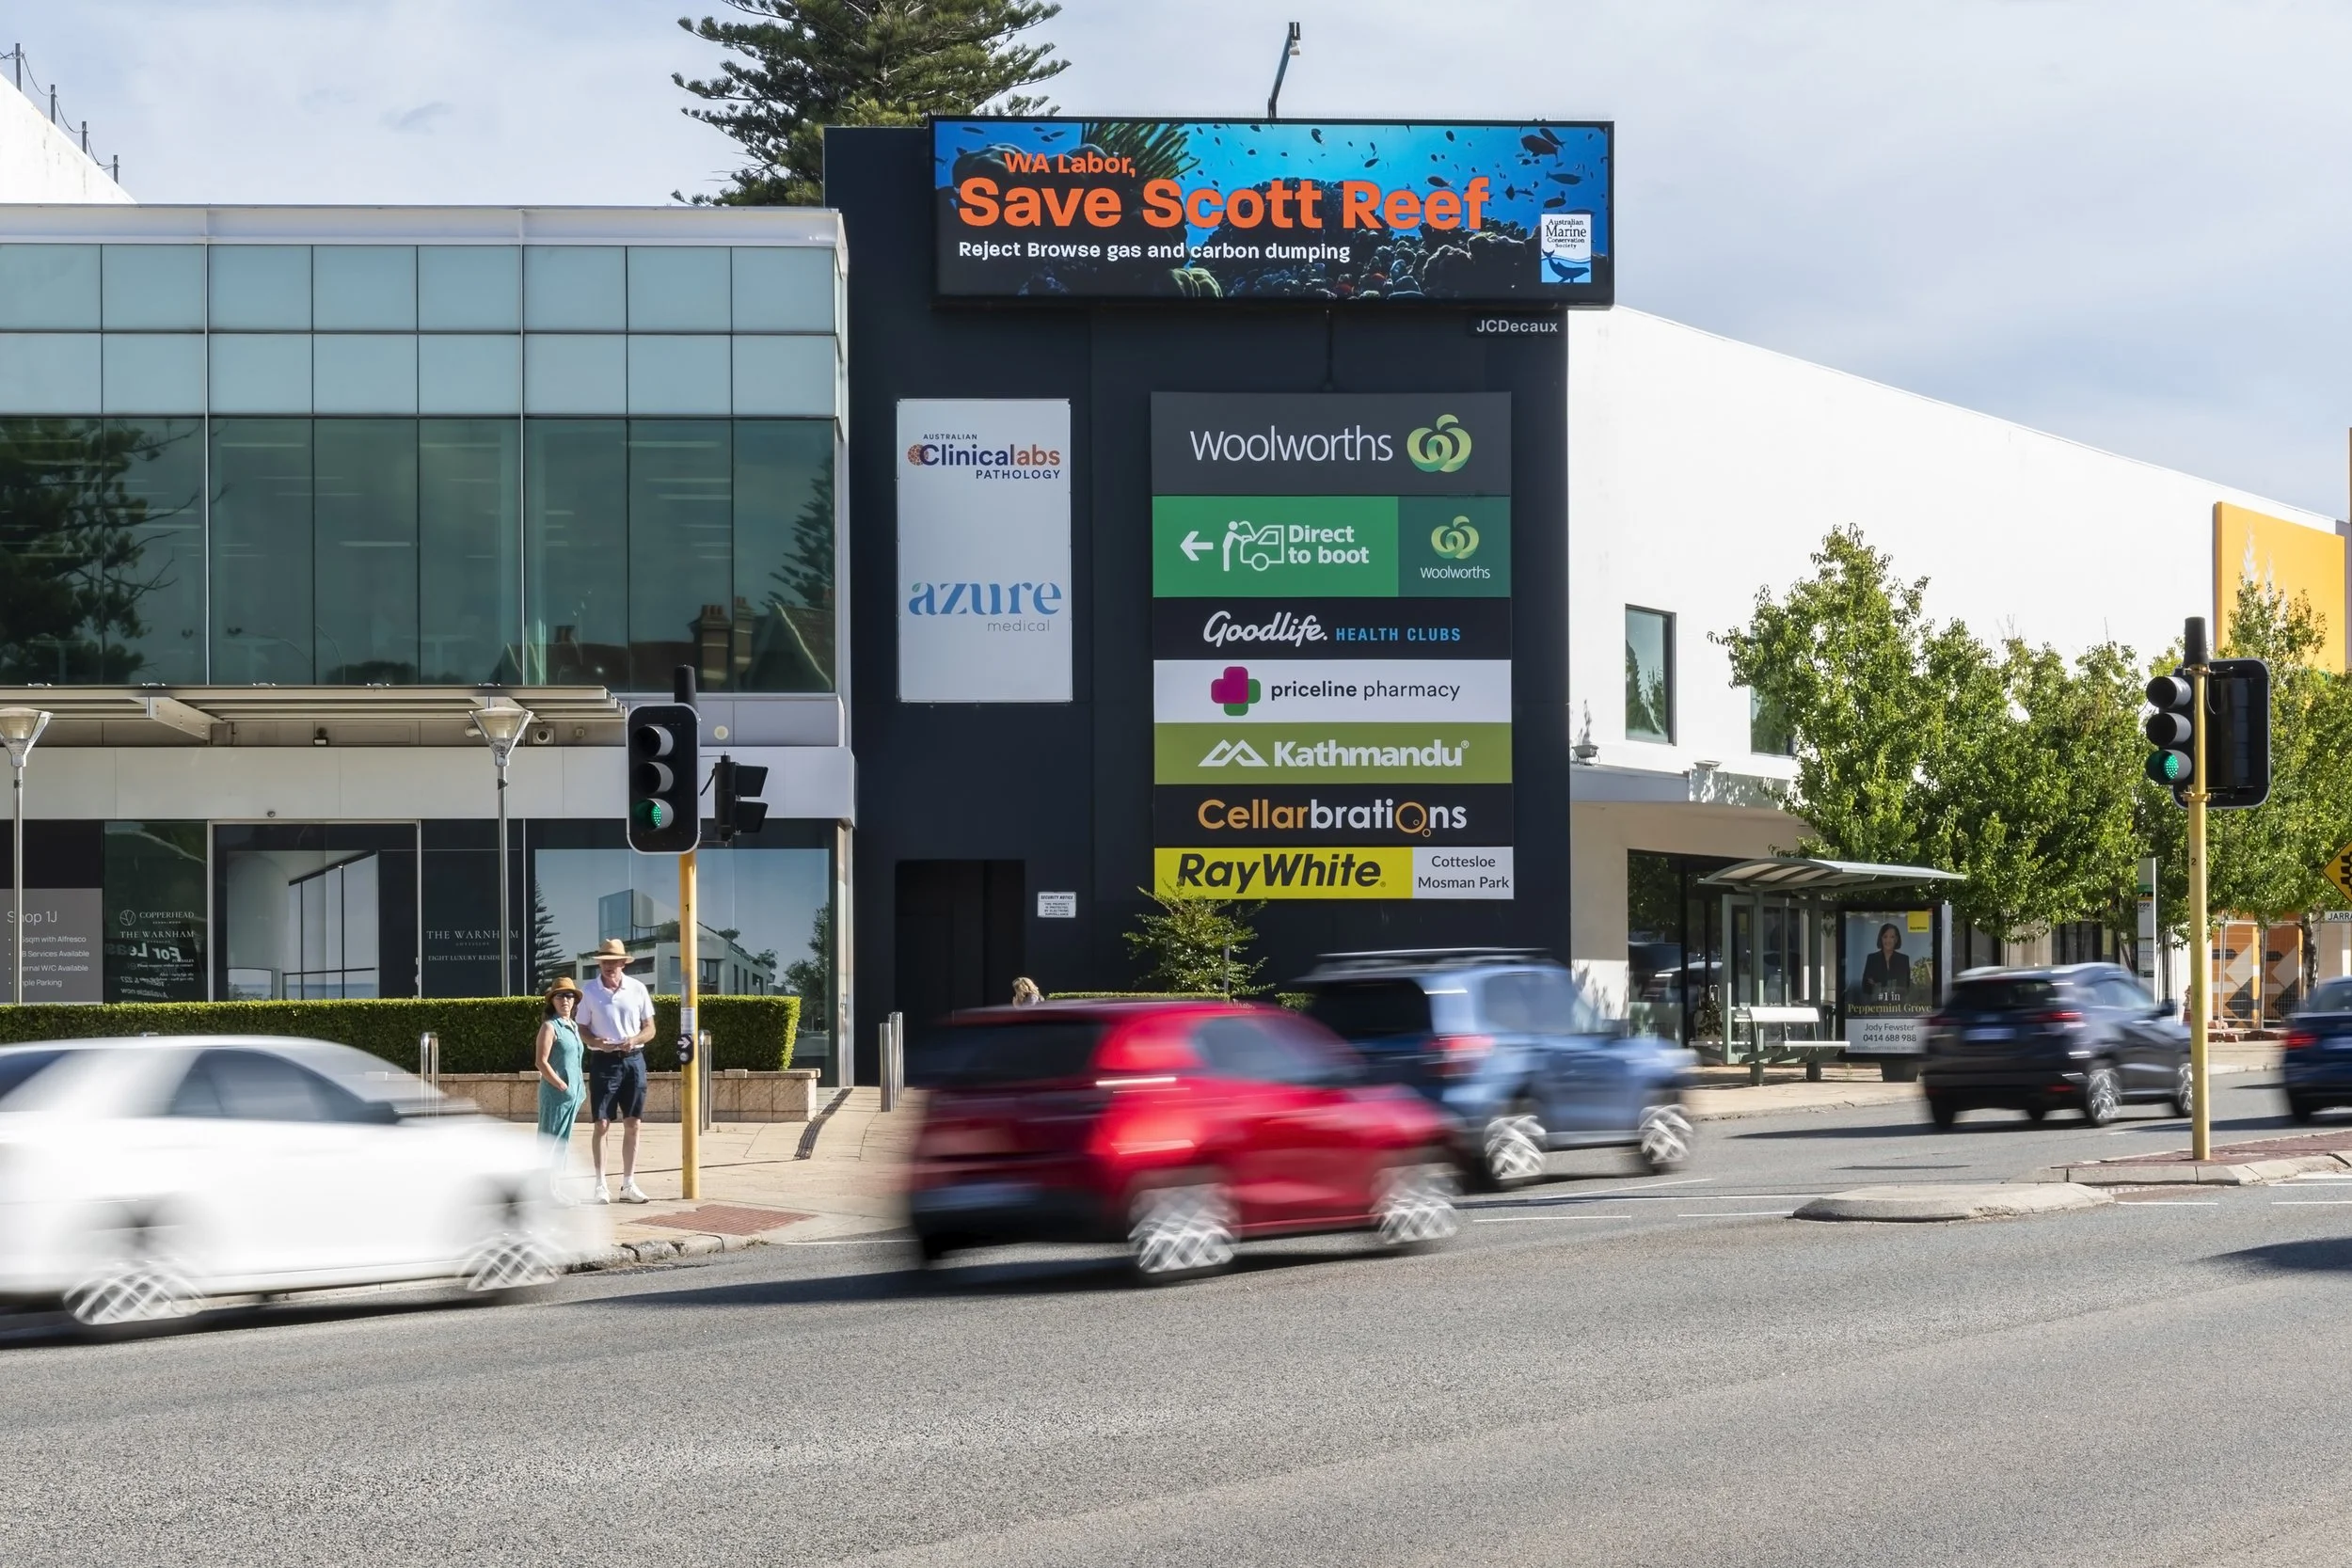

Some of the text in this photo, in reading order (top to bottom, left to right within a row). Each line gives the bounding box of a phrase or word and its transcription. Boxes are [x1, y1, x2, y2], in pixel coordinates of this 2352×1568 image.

[1004, 151, 1136, 178] WA Labor,
[959, 176, 1489, 230] Save Scott Reef
[1546, 225, 1587, 237] Marine
[959, 242, 1350, 263] Reject Browse gas and carbon dumping
[1476, 320, 1558, 332] JCDecaux
[1189, 425, 1393, 462] Woolworths
[919, 444, 1061, 467] Clinicalabs
[976, 469, 1061, 480] PATHOLOGY
[1289, 525, 1355, 544] Direct
[1288, 546, 1370, 564] to boot
[1420, 565, 1491, 579] Woolworths
[909, 582, 1062, 615] azure
[987, 619, 1050, 632] medical
[1335, 627, 1399, 641] HEALTH
[1406, 627, 1461, 641] CLUBS
[1270, 680, 1460, 702] priceline pharmacy
[1198, 799, 1468, 837] Cellarbrations
[1431, 855, 1496, 868] Cottesloe
[1418, 876, 1509, 889] Mosman Park
[7, 911, 57, 926] Sop 1J
[142, 930, 194, 939] WARNHAM
[426, 930, 518, 940] THE WARNHM
[36, 979, 62, 988] Parking
[1878, 991, 1900, 1002] #1 in
[1848, 1004, 1932, 1014] Peppermint Grove
[1865, 1023, 1883, 1032] Jody
